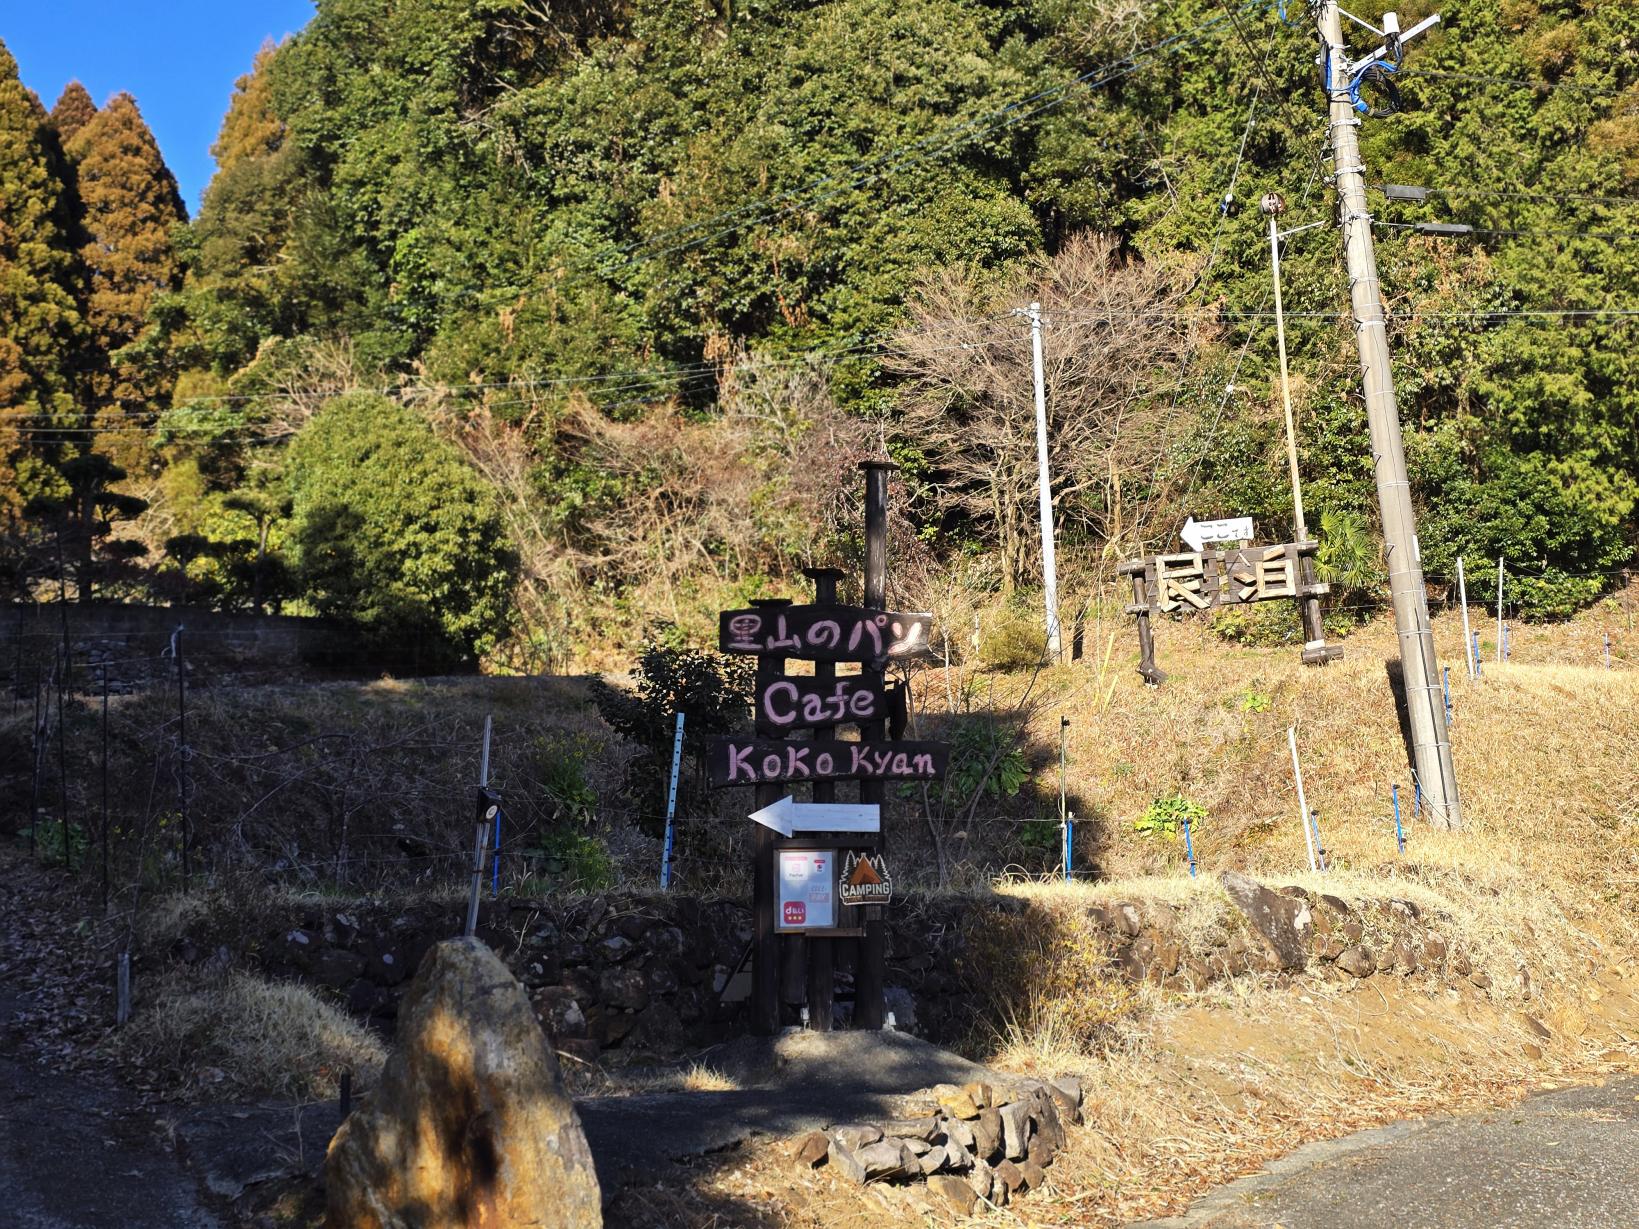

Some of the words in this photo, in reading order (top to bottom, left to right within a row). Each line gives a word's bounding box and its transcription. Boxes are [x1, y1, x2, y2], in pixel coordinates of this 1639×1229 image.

[727, 614, 921, 655] 里山のパン
[764, 681, 875, 724] Cafe
[842, 882, 890, 896] CAMPING
